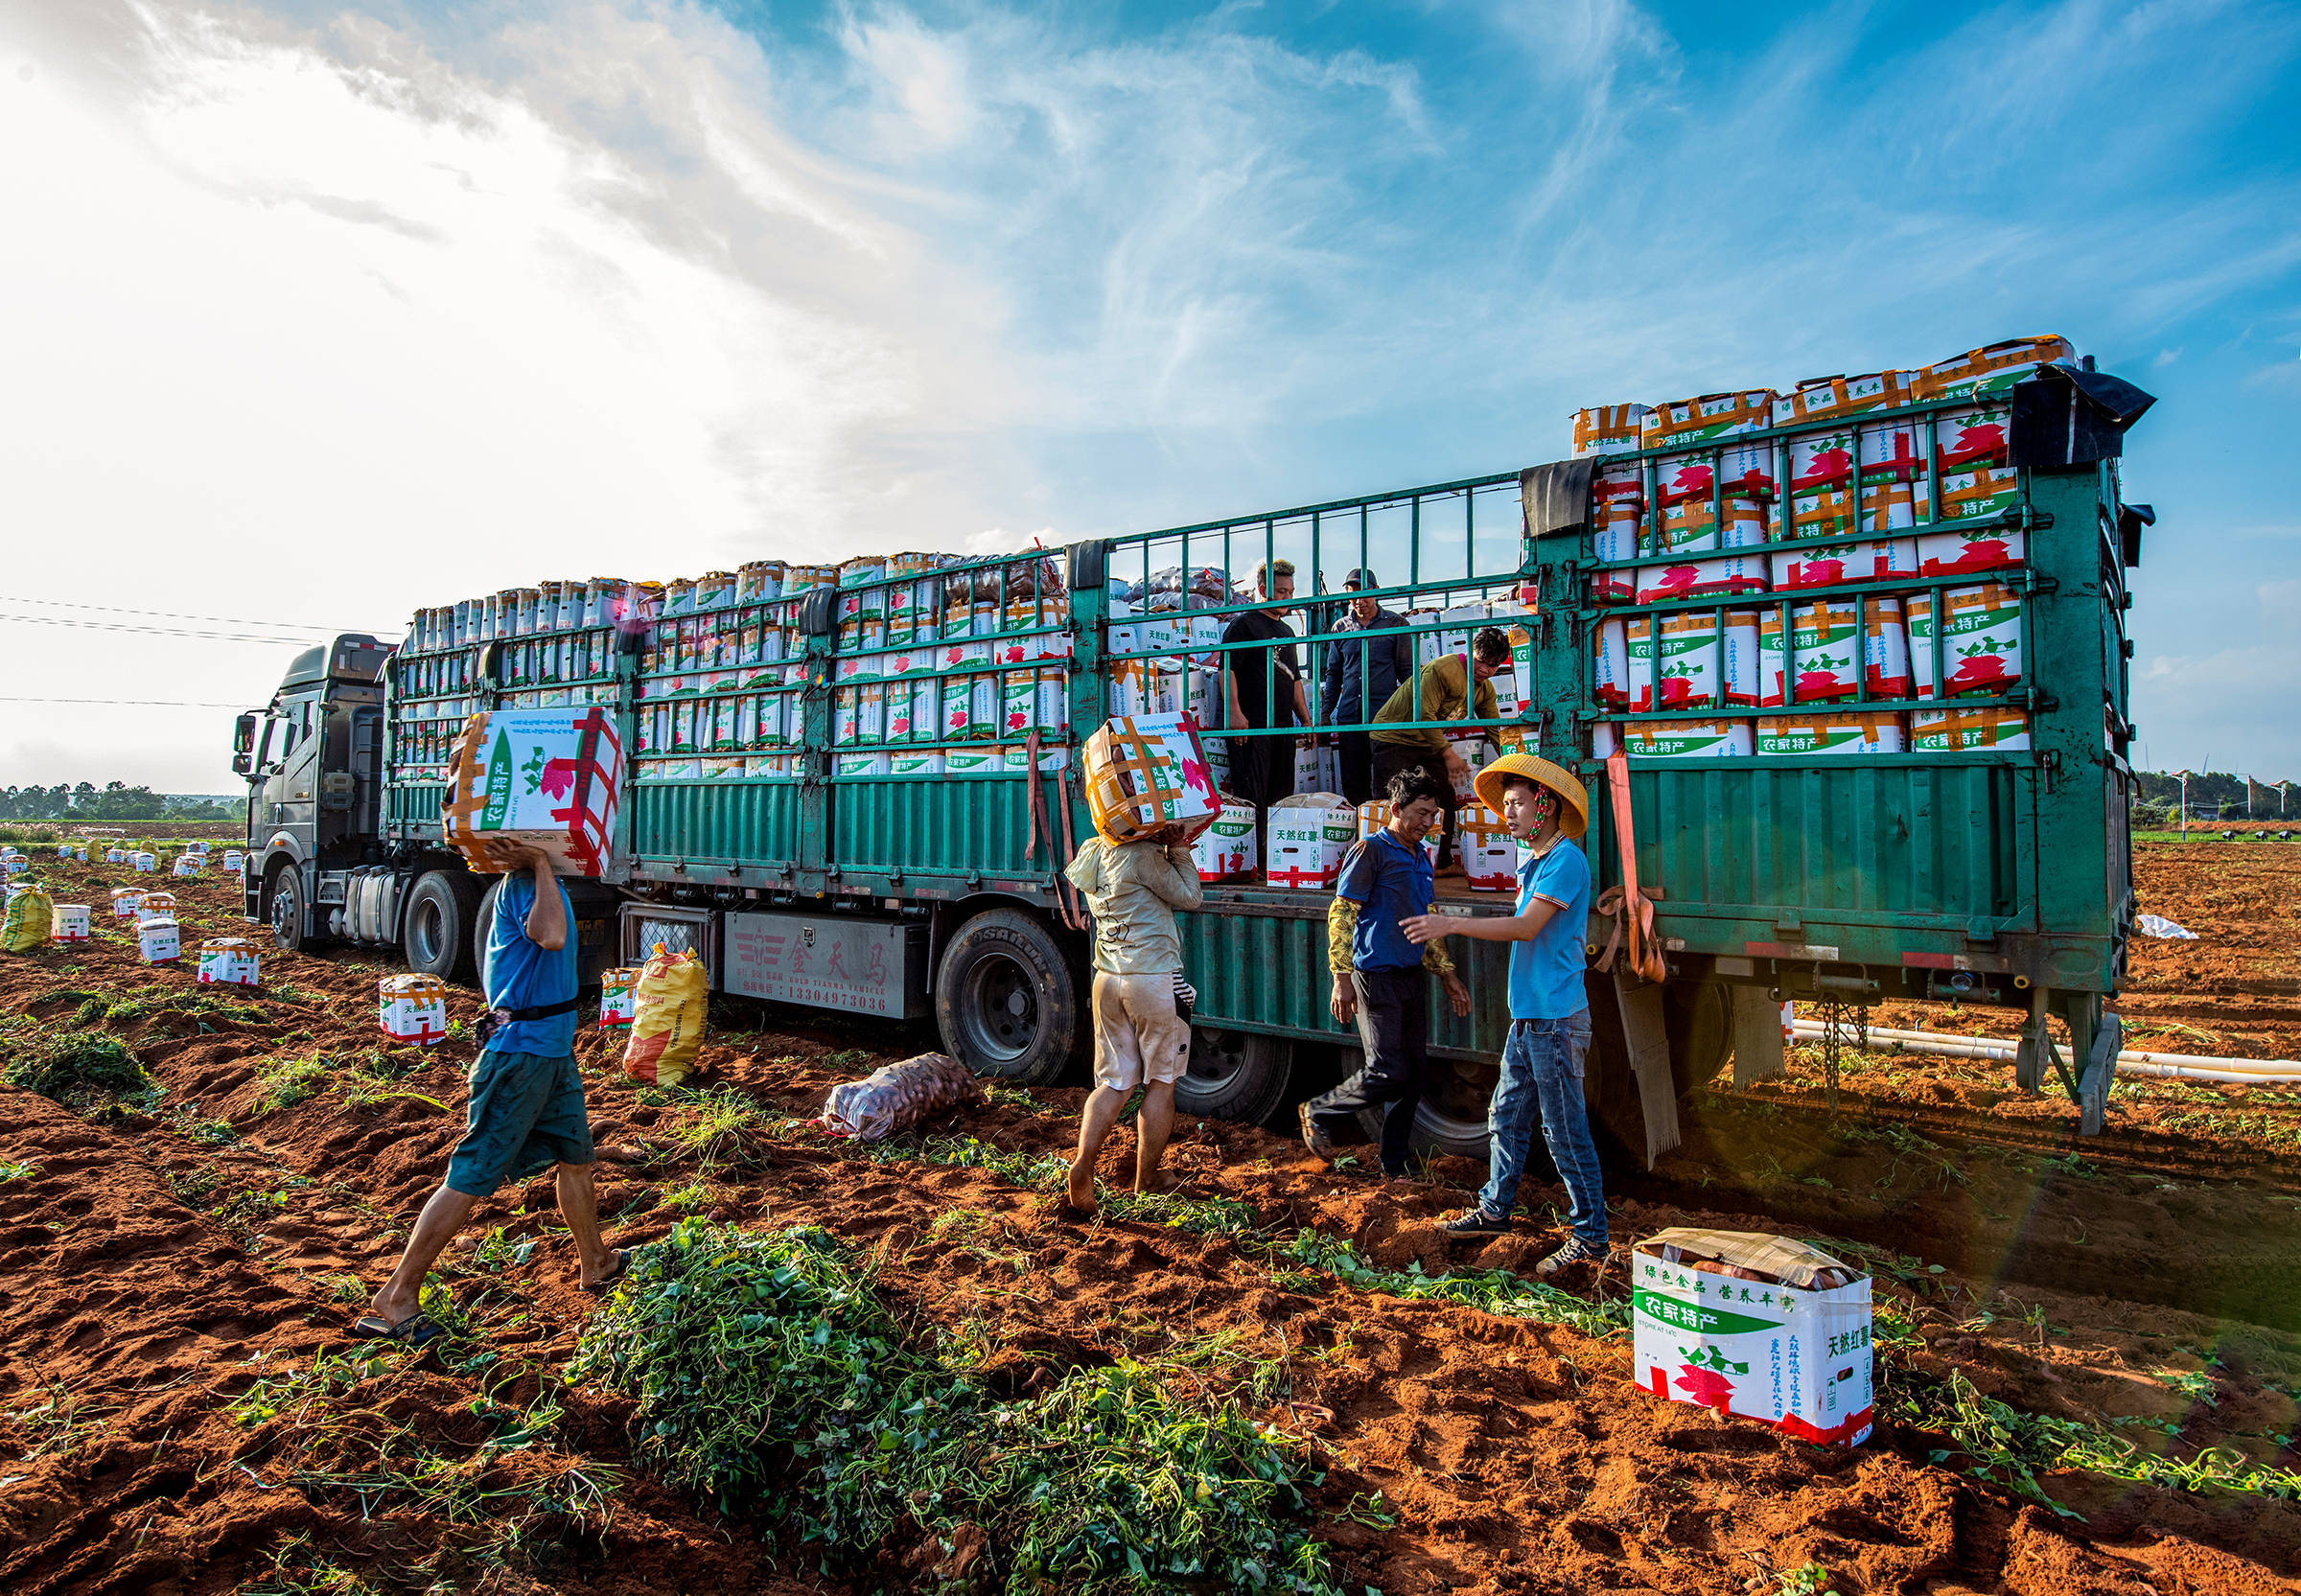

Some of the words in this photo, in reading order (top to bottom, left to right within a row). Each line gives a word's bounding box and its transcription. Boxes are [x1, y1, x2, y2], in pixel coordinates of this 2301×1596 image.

[1276, 829, 1318, 843] 天然红薯
[1644, 1264, 1707, 1294] 绿色食品
[1719, 1284, 1796, 1314] 营养丰富
[1645, 1296, 1718, 1330] 农家特产
[1828, 1325, 1870, 1358] 天然红薯
